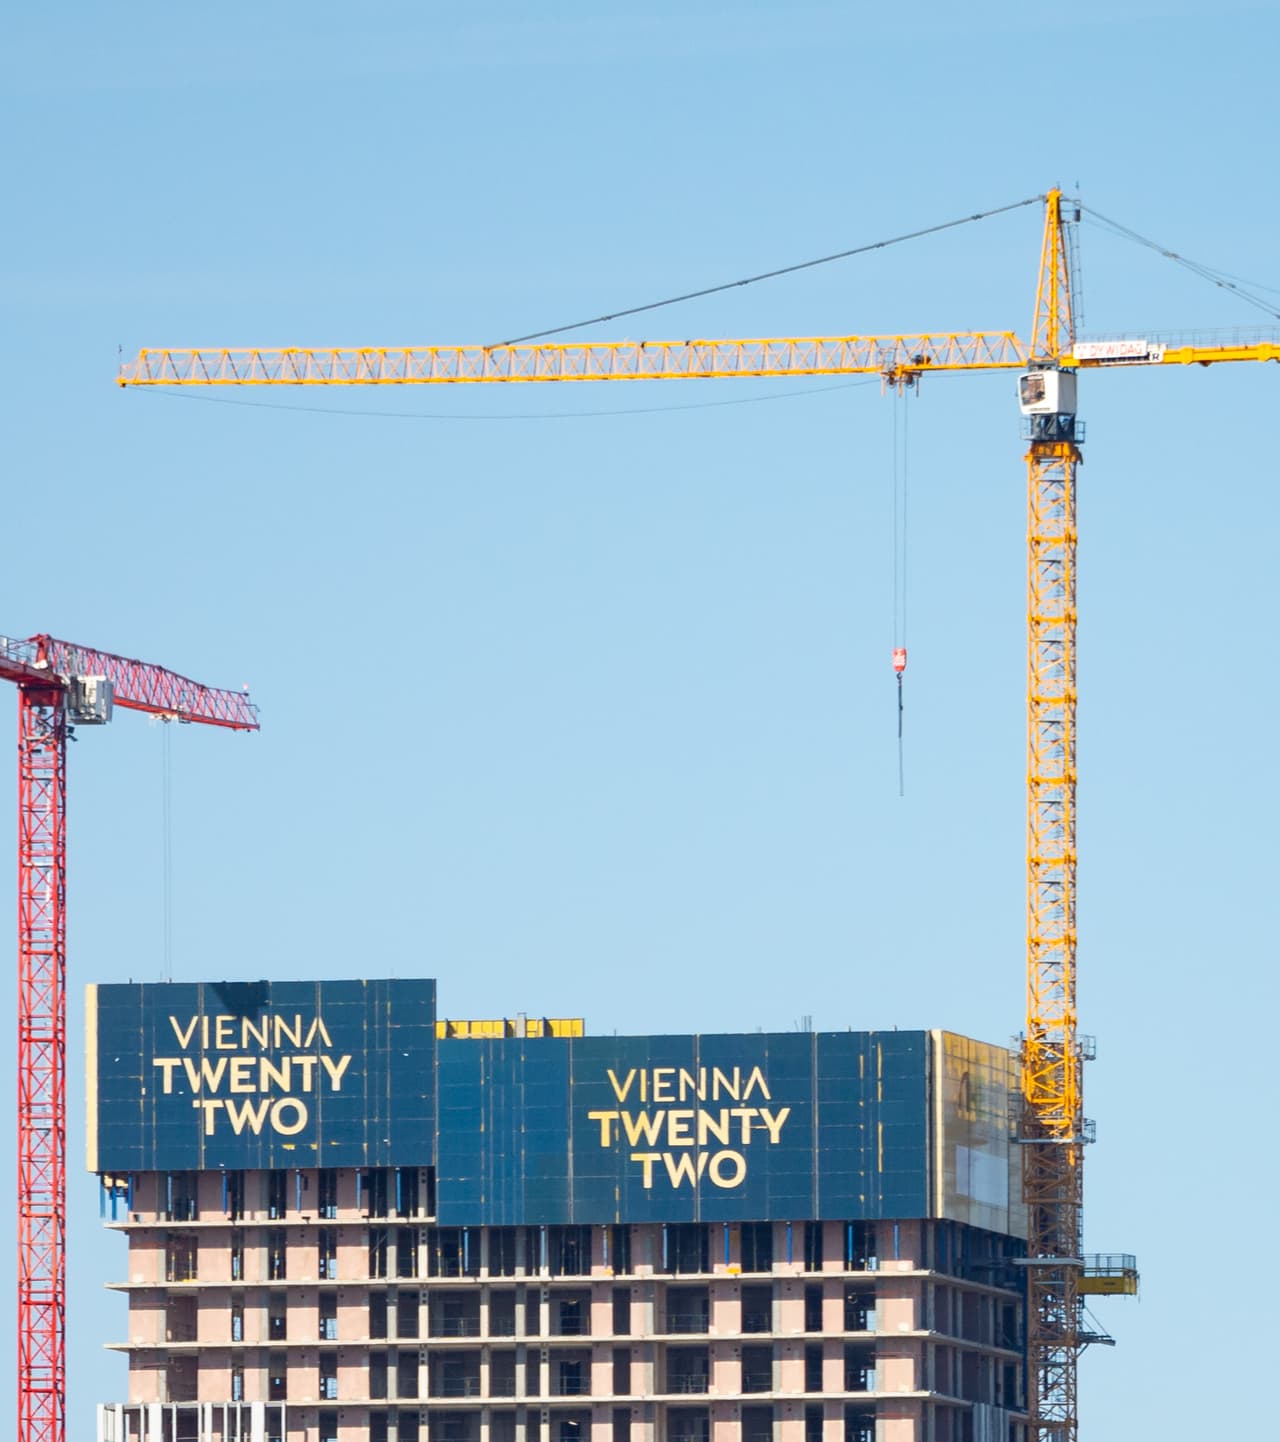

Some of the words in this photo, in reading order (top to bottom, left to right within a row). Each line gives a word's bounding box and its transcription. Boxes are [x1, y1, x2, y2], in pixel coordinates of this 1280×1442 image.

[169, 1015, 333, 1050] VIENNA
[152, 1056, 352, 1093] TWENTY
[608, 1067, 771, 1102] VIENNA
[193, 1098, 308, 1136] TWO
[588, 1108, 791, 1147] TWENTY
[631, 1150, 747, 1189] TWO
